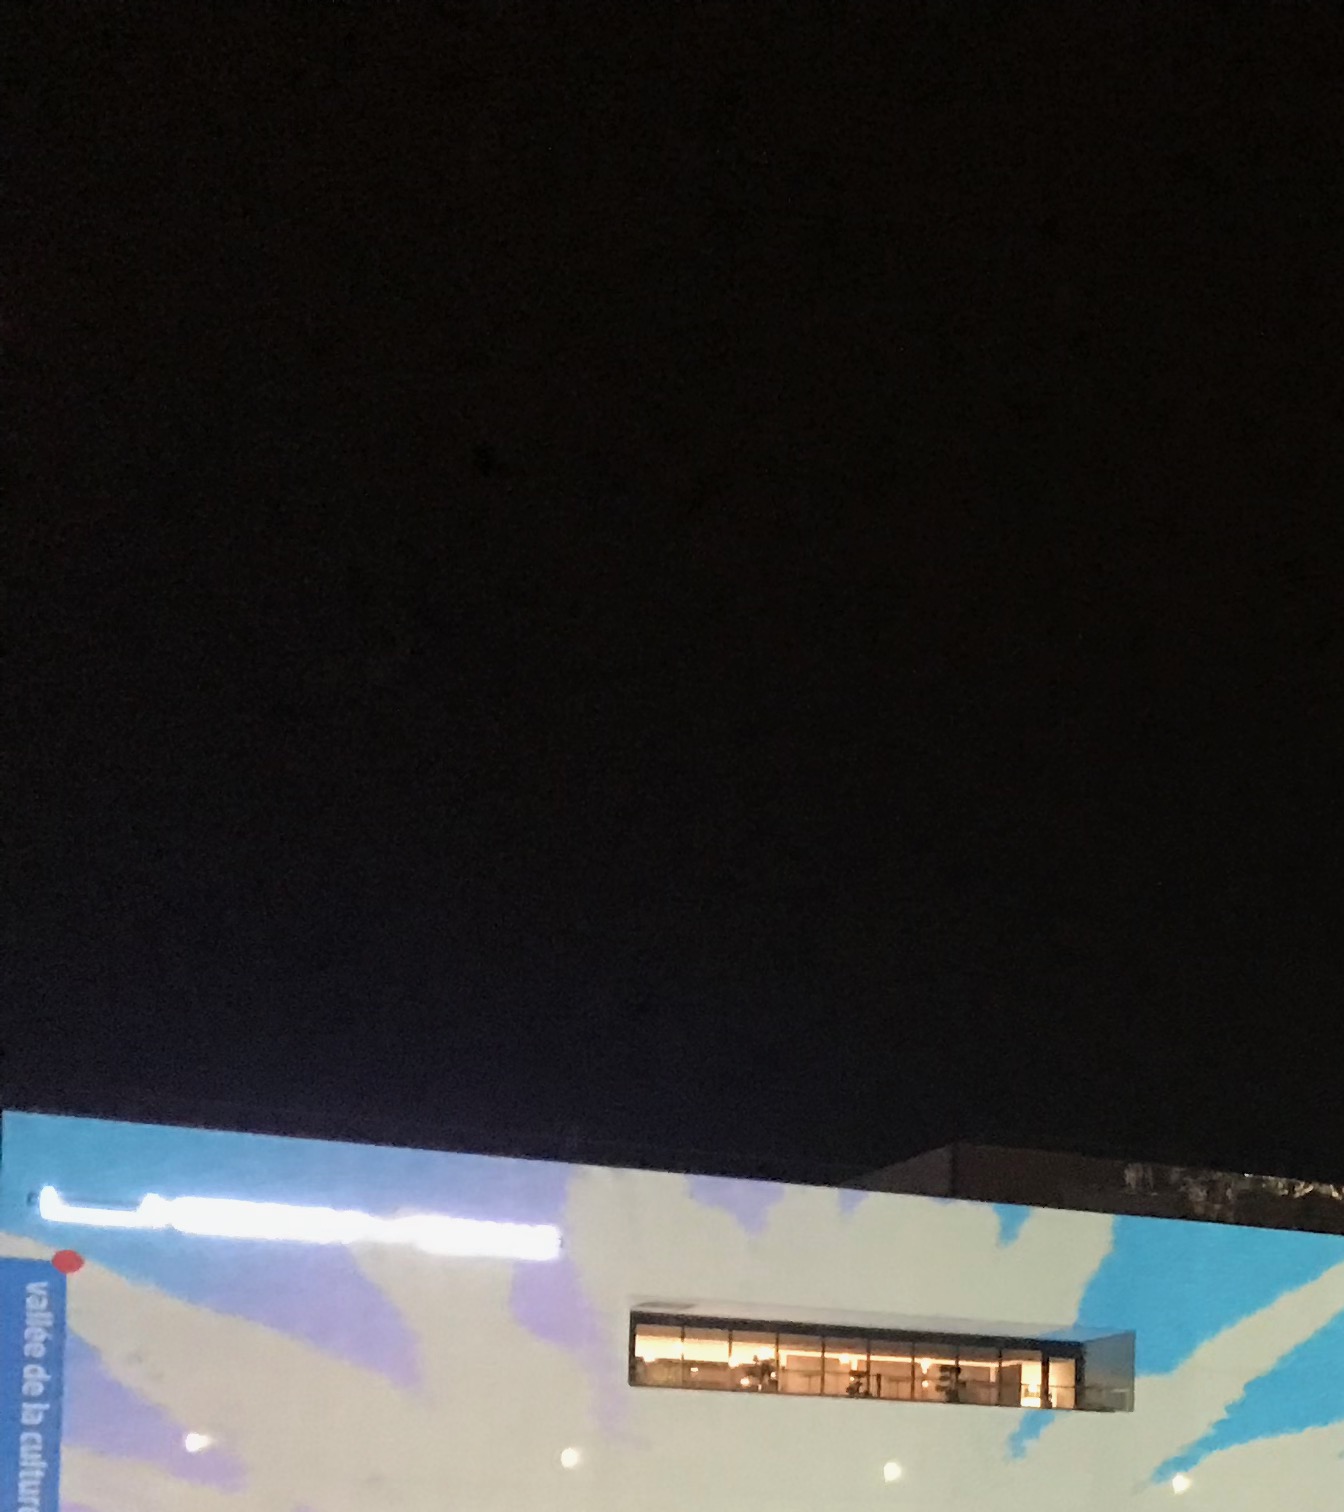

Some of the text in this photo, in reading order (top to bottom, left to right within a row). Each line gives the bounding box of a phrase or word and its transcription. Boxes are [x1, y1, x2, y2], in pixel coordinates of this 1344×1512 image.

[24, 1281, 54, 1358] vallée
[22, 1364, 52, 1397] de
[21, 1402, 50, 1425] la
